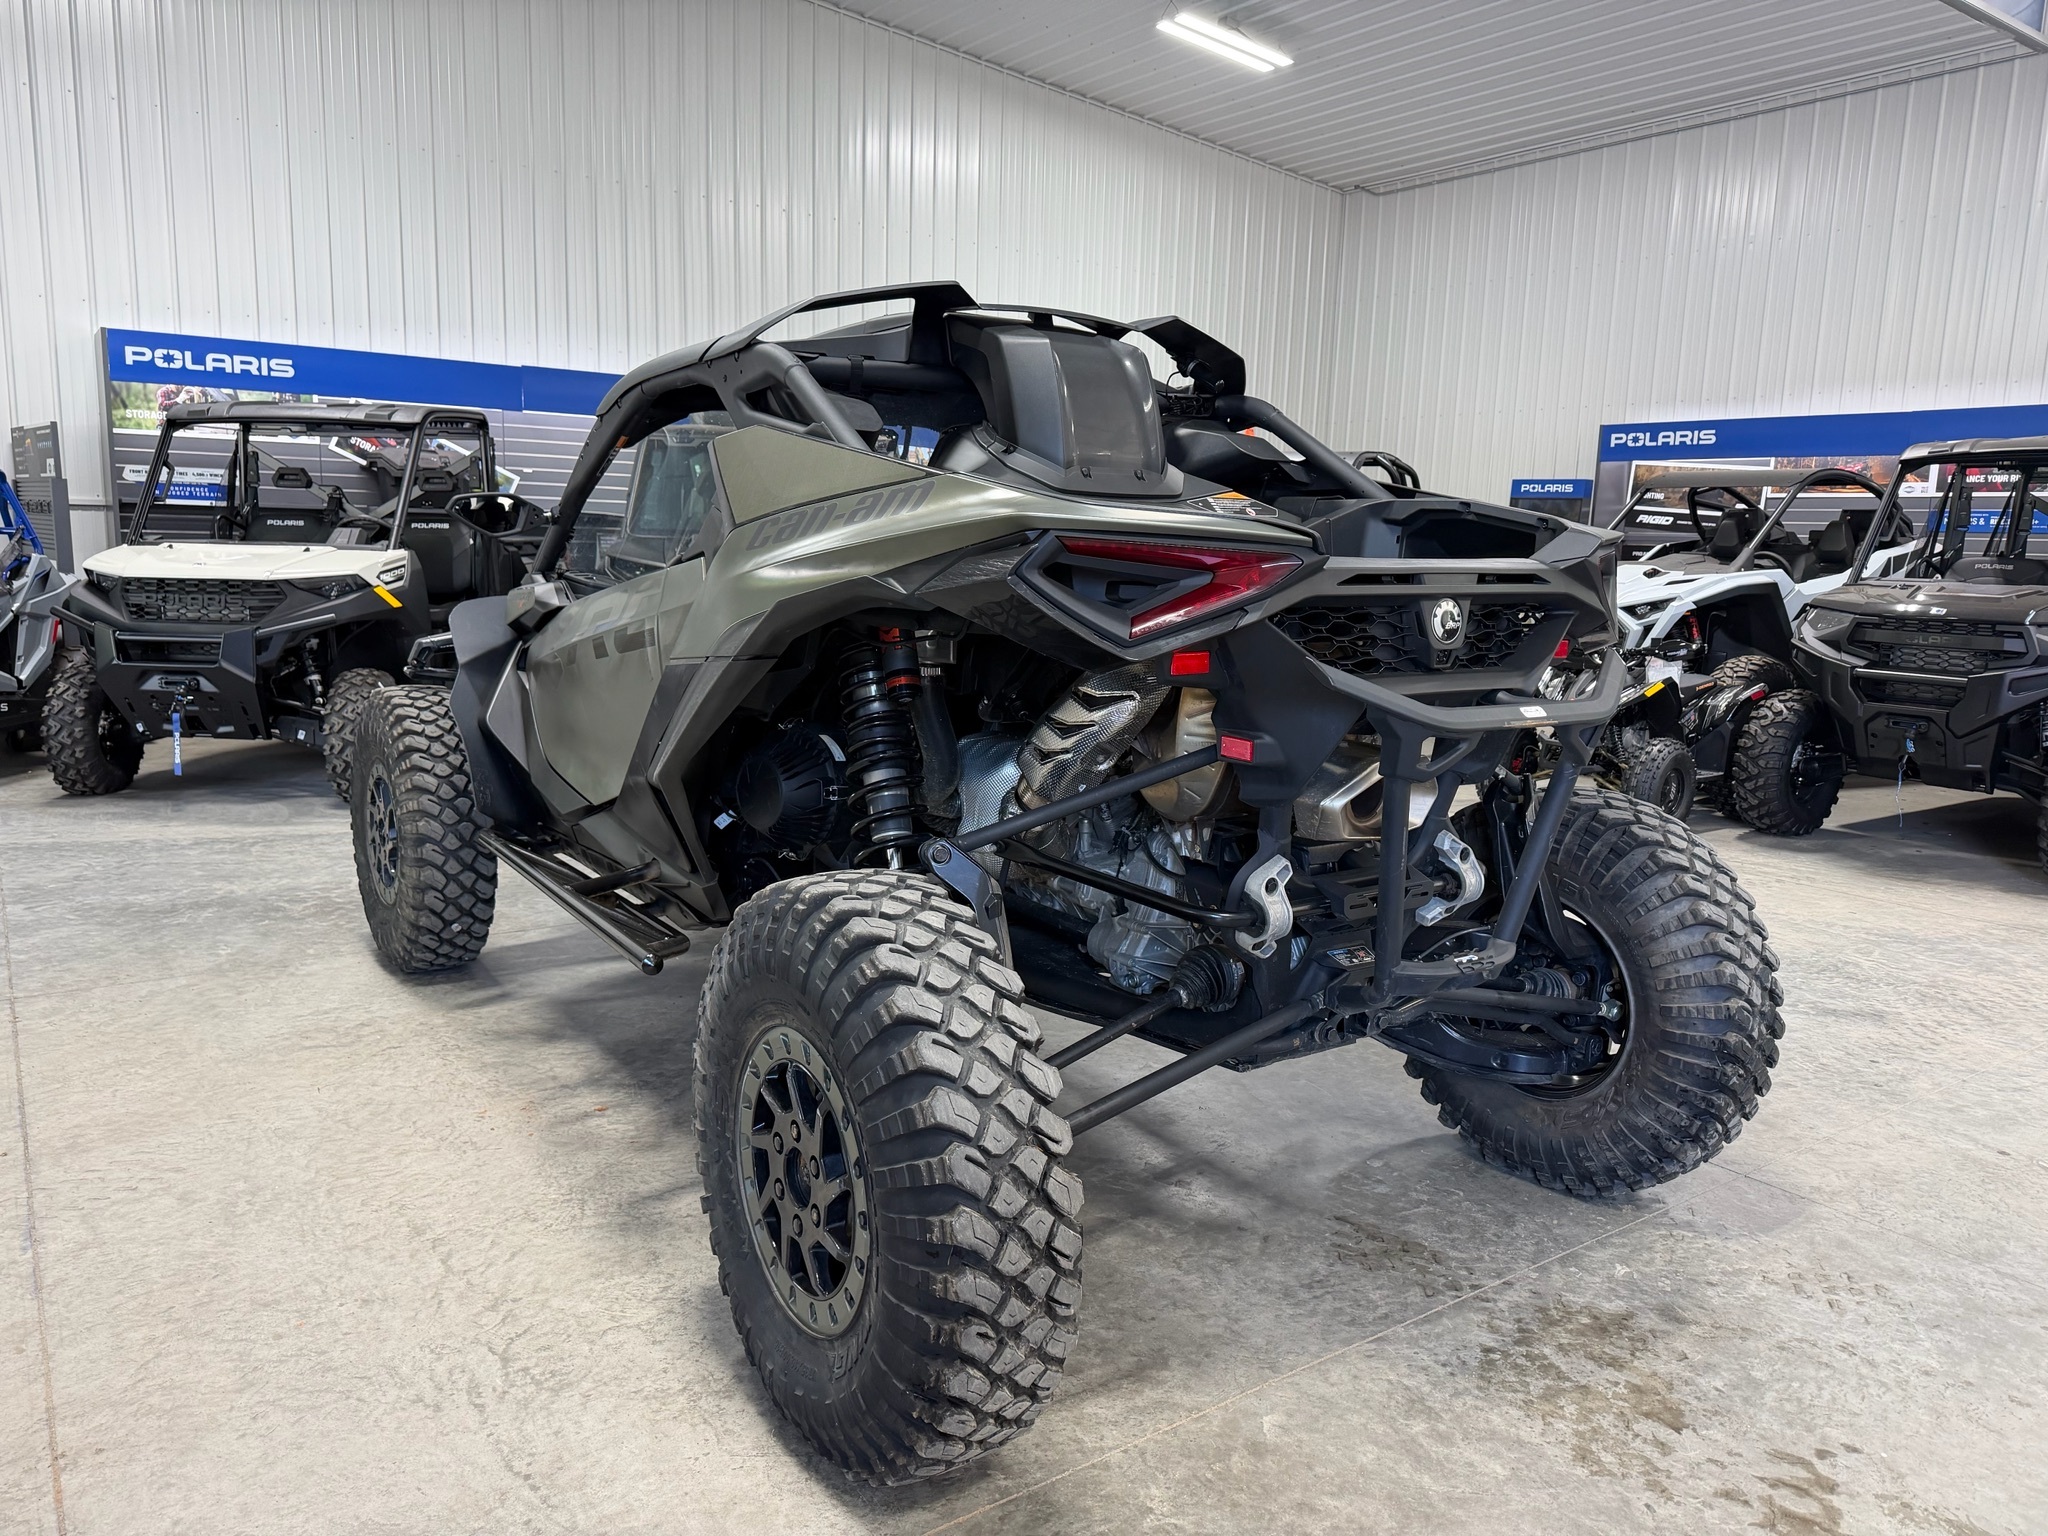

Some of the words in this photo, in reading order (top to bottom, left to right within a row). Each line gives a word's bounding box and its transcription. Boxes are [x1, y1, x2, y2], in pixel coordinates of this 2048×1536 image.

[124, 345, 295, 378] POLARIS
[350, 436, 379, 453] STORA
[1610, 430, 1717, 448] POLARIS
[1987, 474, 2008, 483] YOUR
[1520, 484, 1574, 493] POLARIS
[1636, 514, 1675, 526] RIGID
[1974, 563, 2014, 571] POLARIS
[379, 568, 405, 581] 1000
[143, 593, 242, 609] POLARIS
